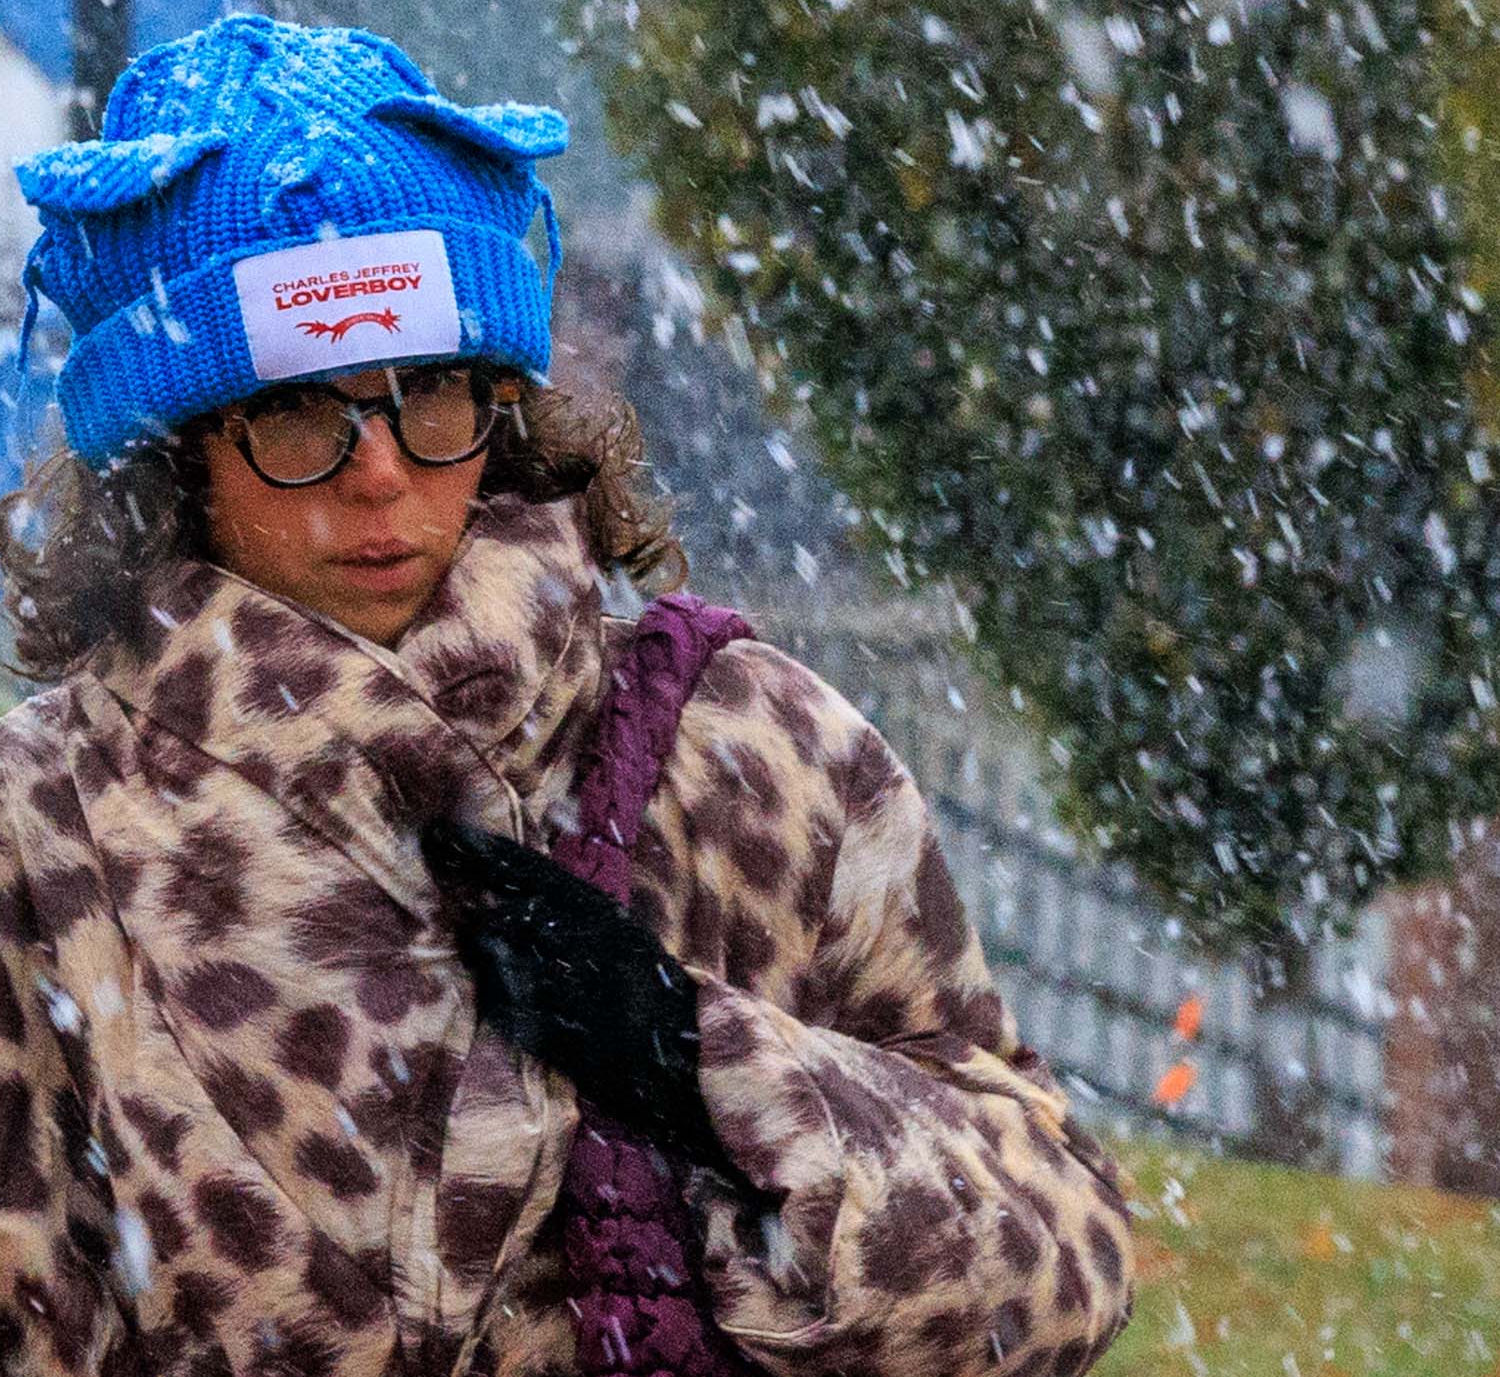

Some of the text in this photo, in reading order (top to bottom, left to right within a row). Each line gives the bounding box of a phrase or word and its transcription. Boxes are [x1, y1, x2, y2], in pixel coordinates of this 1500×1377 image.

[271, 263, 420, 294] CHARLES JEFFREY
[275, 275, 422, 311] LOVERBOY
